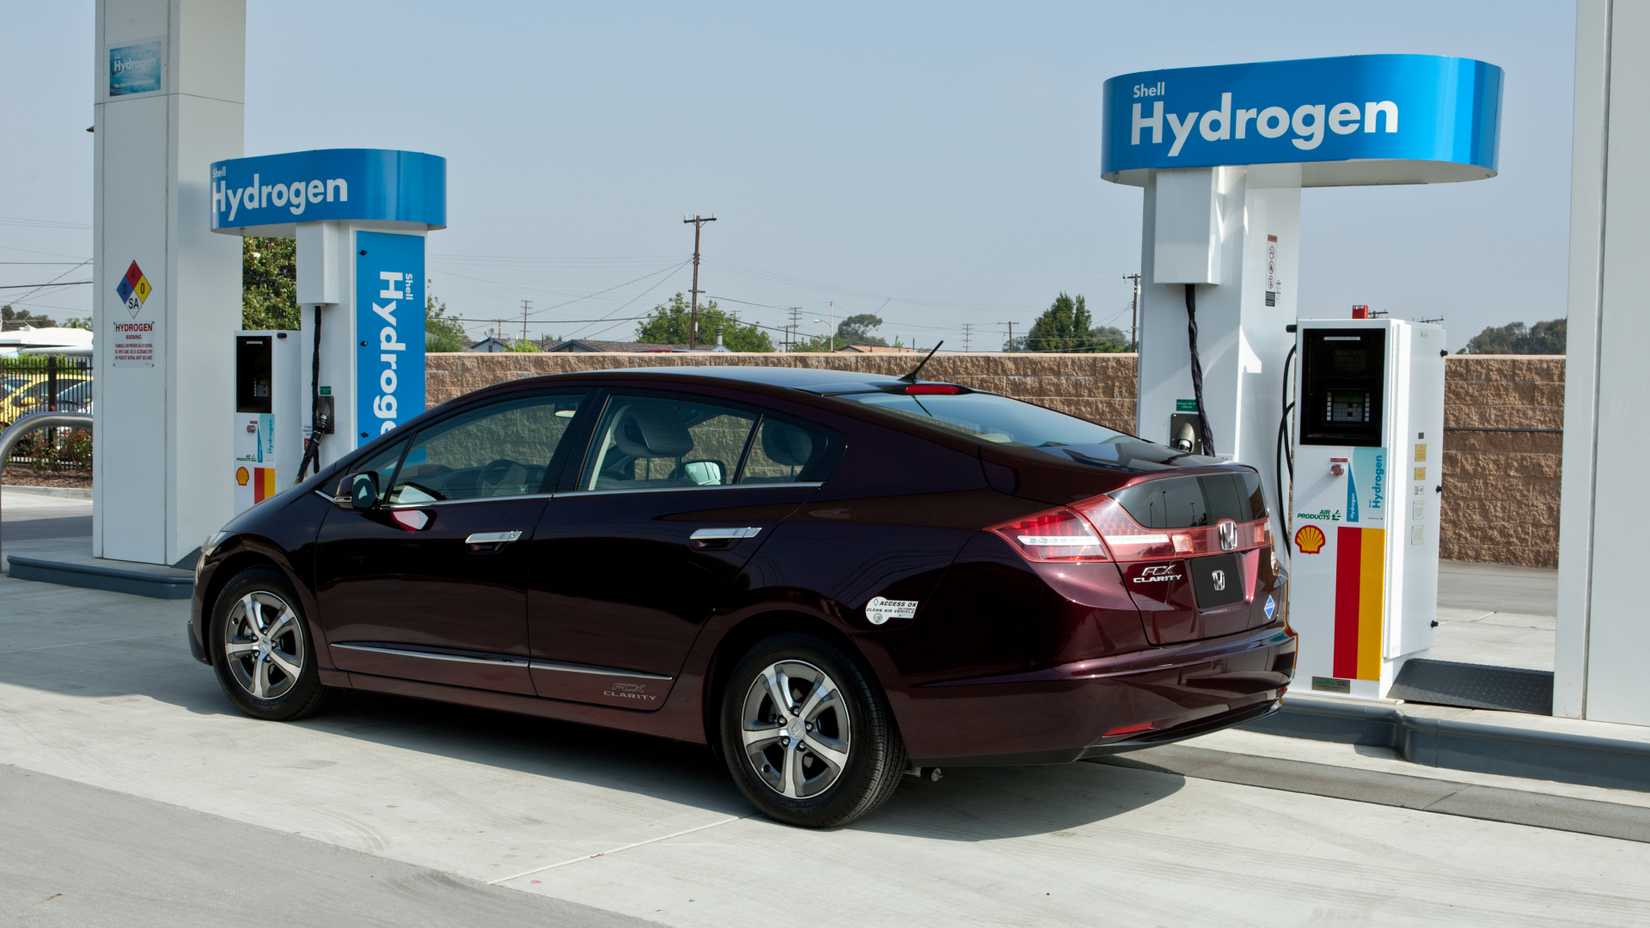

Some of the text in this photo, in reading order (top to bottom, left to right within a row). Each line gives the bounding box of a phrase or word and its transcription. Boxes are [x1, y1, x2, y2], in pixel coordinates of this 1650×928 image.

[1133, 81, 1166, 98] Shell
[1130, 92, 1399, 157] Hydrogen
[212, 173, 348, 221] Hydrogen
[405, 273, 414, 300] Shell
[128, 297, 139, 309] SA
[115, 323, 153, 332] HYDROGEN
[372, 271, 406, 435] Hydrog
[1371, 455, 1384, 508] Hydrogen
[1132, 574, 1182, 583] CLARITY
[1141, 564, 1176, 576] FCX
[603, 690, 656, 700] CLARITY
